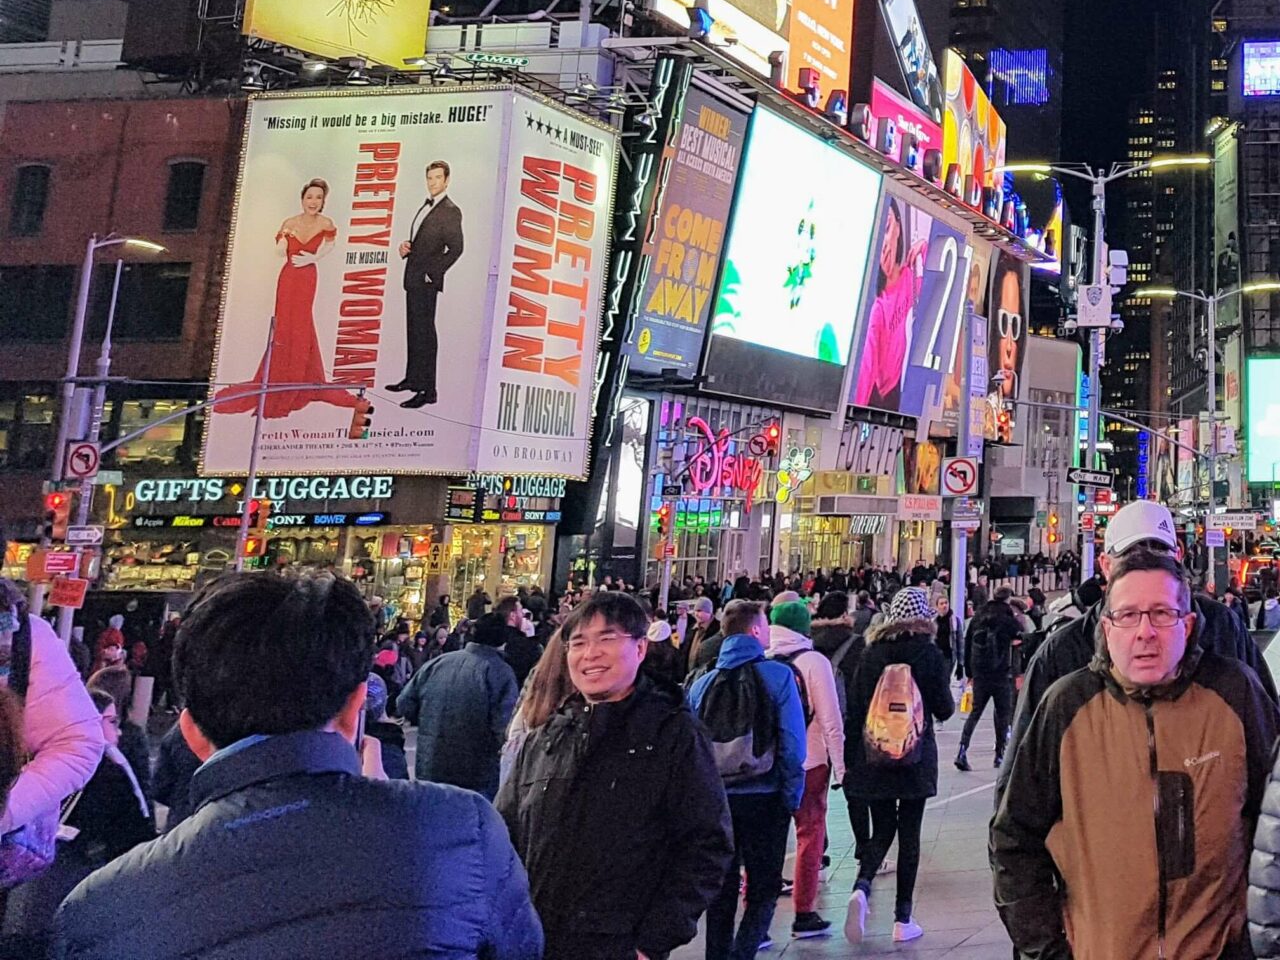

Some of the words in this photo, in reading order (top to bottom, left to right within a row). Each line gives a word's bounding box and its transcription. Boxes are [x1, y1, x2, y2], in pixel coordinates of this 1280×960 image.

[310, 114, 319, 128] it
[322, 113, 351, 127] would
[355, 113, 367, 126] be
[371, 115, 377, 126] a
[381, 113, 396, 127] big
[400, 112, 444, 125] mistake.
[680, 123, 702, 156] BEST
[702, 133, 736, 171] MUSICAL
[348, 142, 401, 247] PRETTY
[665, 204, 722, 254] COME
[346, 251, 357, 264] THE
[358, 251, 388, 264] MUSICAL
[501, 154, 562, 375] WOMAN
[544, 162, 598, 388] PRETTY
[655, 239, 716, 289] FROM
[646, 277, 709, 325] AWAY
[923, 236, 974, 374] 21
[333, 268, 387, 390] WOMAN
[497, 382, 521, 431] THE
[523, 385, 576, 438] MUSICAL
[493, 445, 509, 459] ON
[513, 446, 574, 464] BROADWAY
[135, 479, 223, 502] GIFTS
[249, 476, 393, 500] LUGGAGE
[466, 473, 504, 495] FTS
[512, 475, 566, 497] LUGGAGE
[1074, 472, 1087, 480] ONE
[1093, 475, 1108, 483] WAY
[143, 518, 164, 526] Apple
[171, 516, 205, 527] Nikon
[314, 515, 346, 524] BOWER
[524, 511, 545, 520] SONY
[849, 516, 876, 534] FOREVER
[430, 545, 440, 570] ATM
